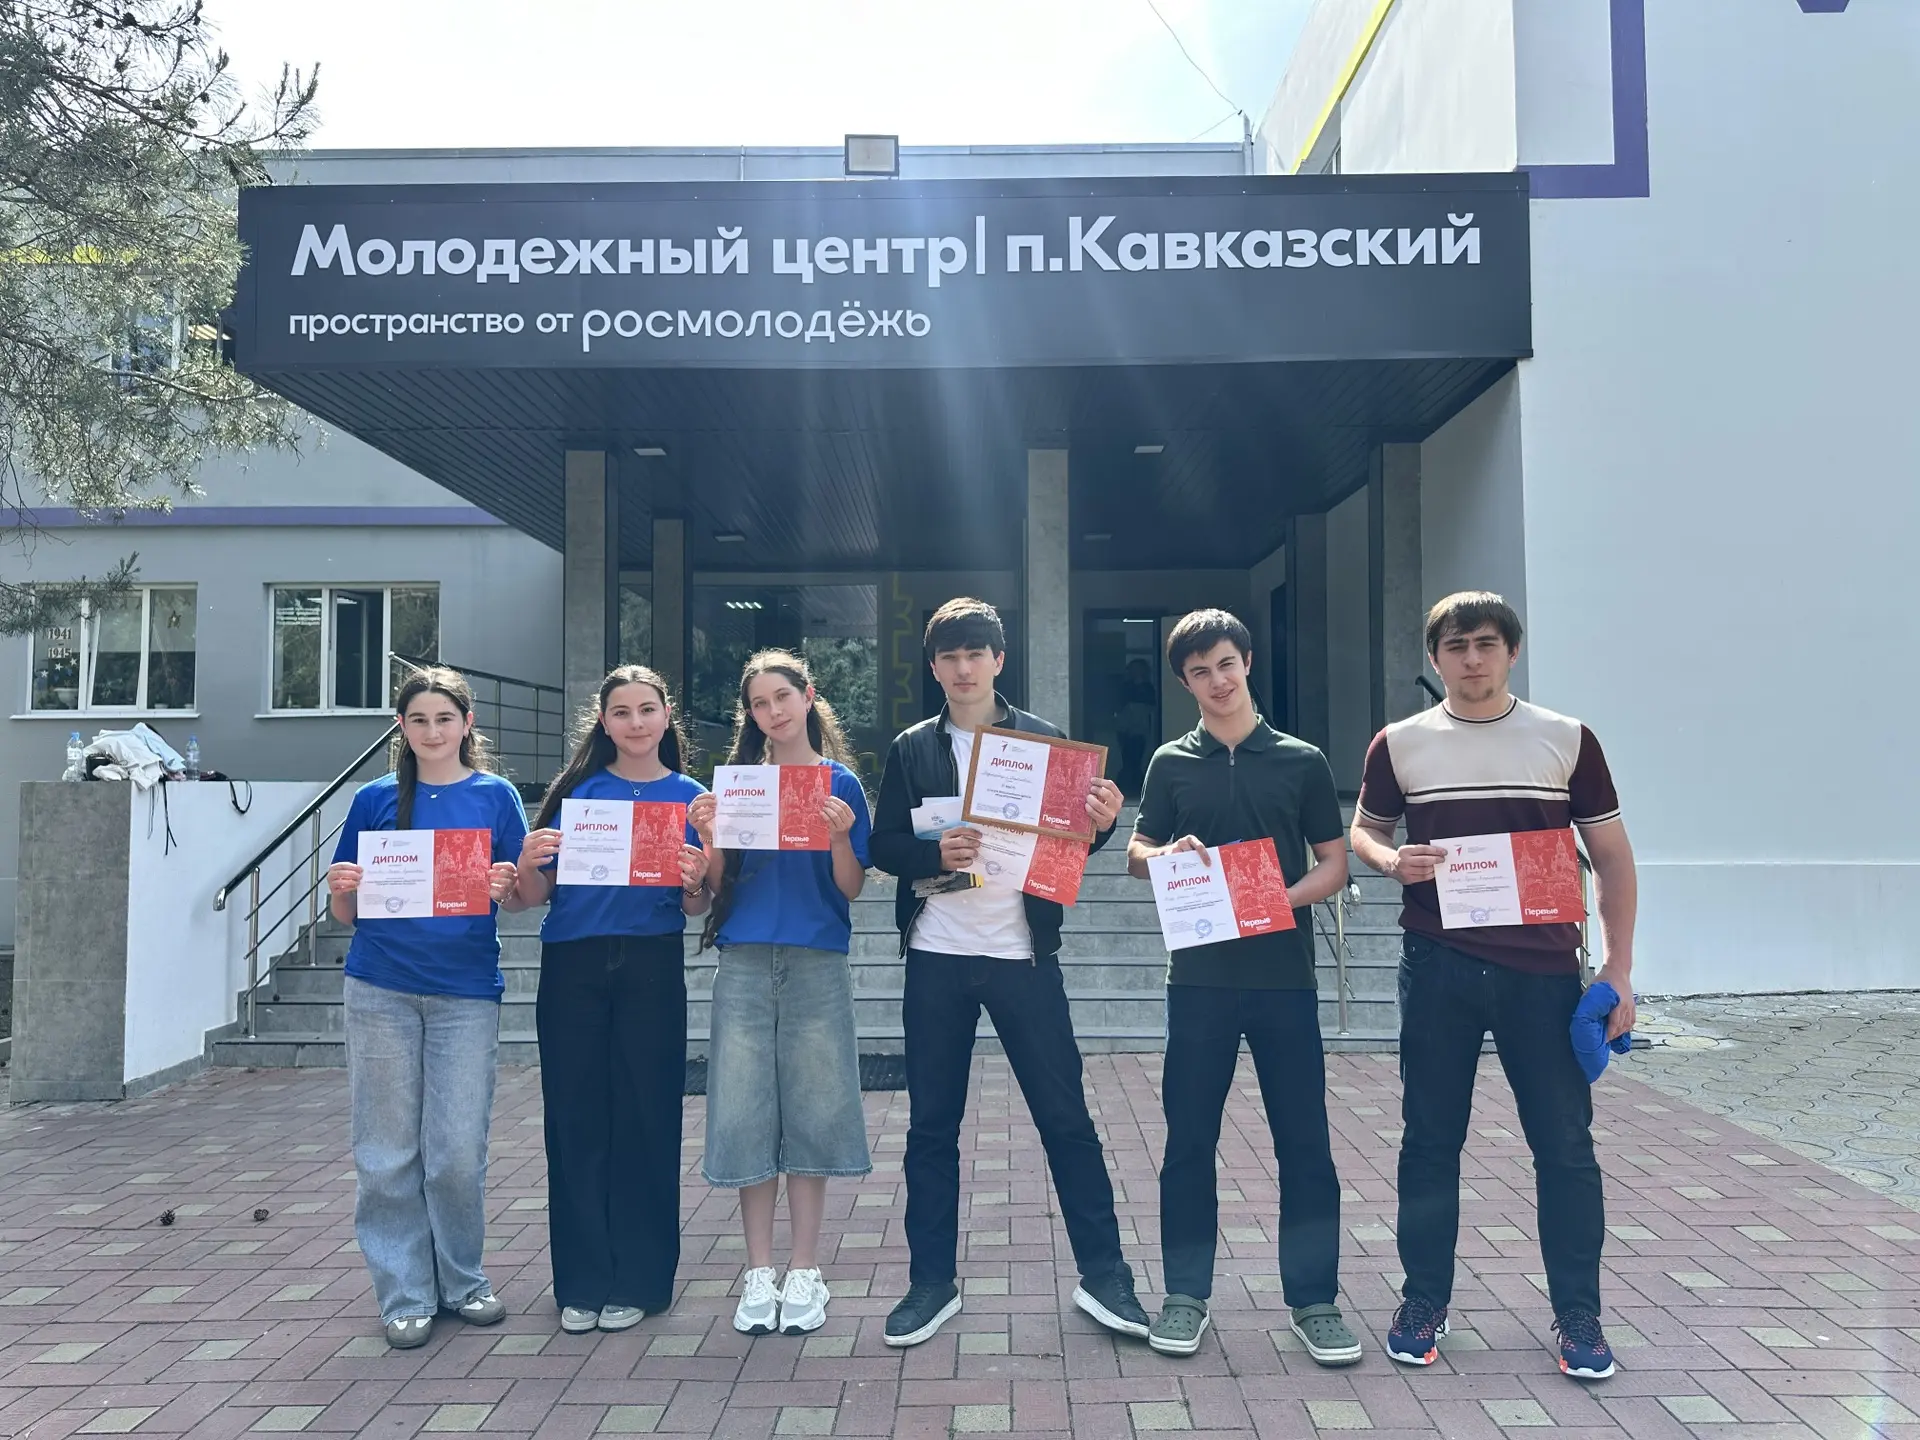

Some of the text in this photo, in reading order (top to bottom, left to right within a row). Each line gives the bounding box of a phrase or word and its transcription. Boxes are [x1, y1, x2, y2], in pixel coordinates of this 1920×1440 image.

[290, 224, 750, 284] Молодежный
[1006, 212, 1482, 273] п.Кавказский
[289, 300, 933, 353] пространство от росмолодёжь
[49, 627, 72, 640] 1941
[991, 757, 1033, 771] ДИПЛОМ
[724, 788, 765, 798] ДИПЛОМ
[574, 822, 618, 833] ДИПЛОМ
[372, 854, 418, 866] ДИПЛОМ
[1450, 860, 1498, 873] ДИПЛОМ
[1167, 875, 1211, 891] ДИПЛОМ
